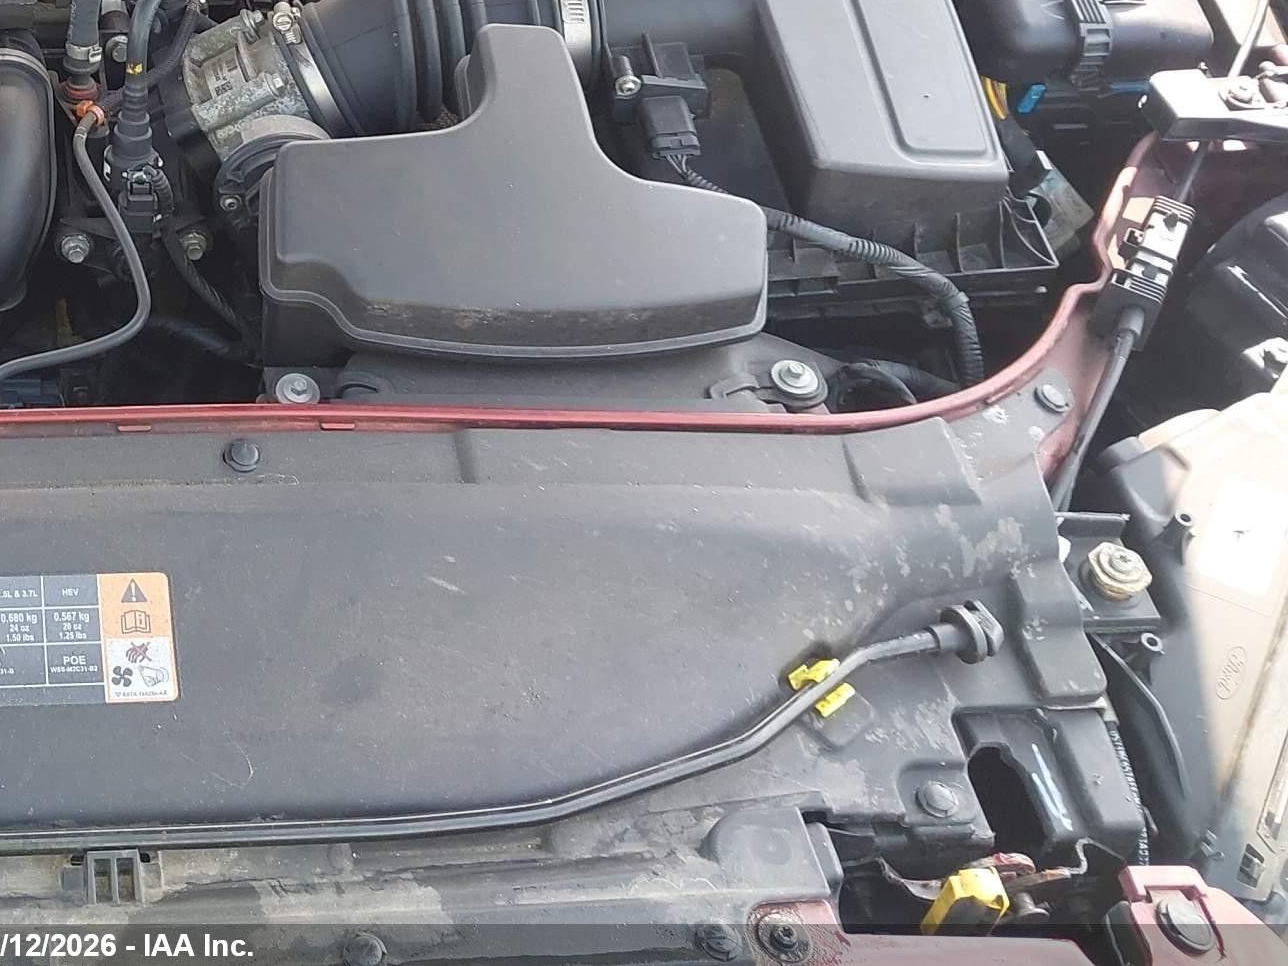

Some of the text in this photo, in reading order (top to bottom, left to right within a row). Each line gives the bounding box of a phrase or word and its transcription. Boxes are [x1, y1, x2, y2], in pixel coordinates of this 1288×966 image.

[22, 589, 38, 597] 3.7L
[62, 588, 79, 596] HEV
[0, 612, 37, 624] 0.680 kg
[53, 611, 90, 623] 0.567 kg
[9, 624, 19, 632] 24
[62, 622, 72, 630] 20
[6, 633, 35, 642] 1.50 lbs
[59, 631, 87, 640] 1.25 lbs
[63, 655, 87, 665] POE
